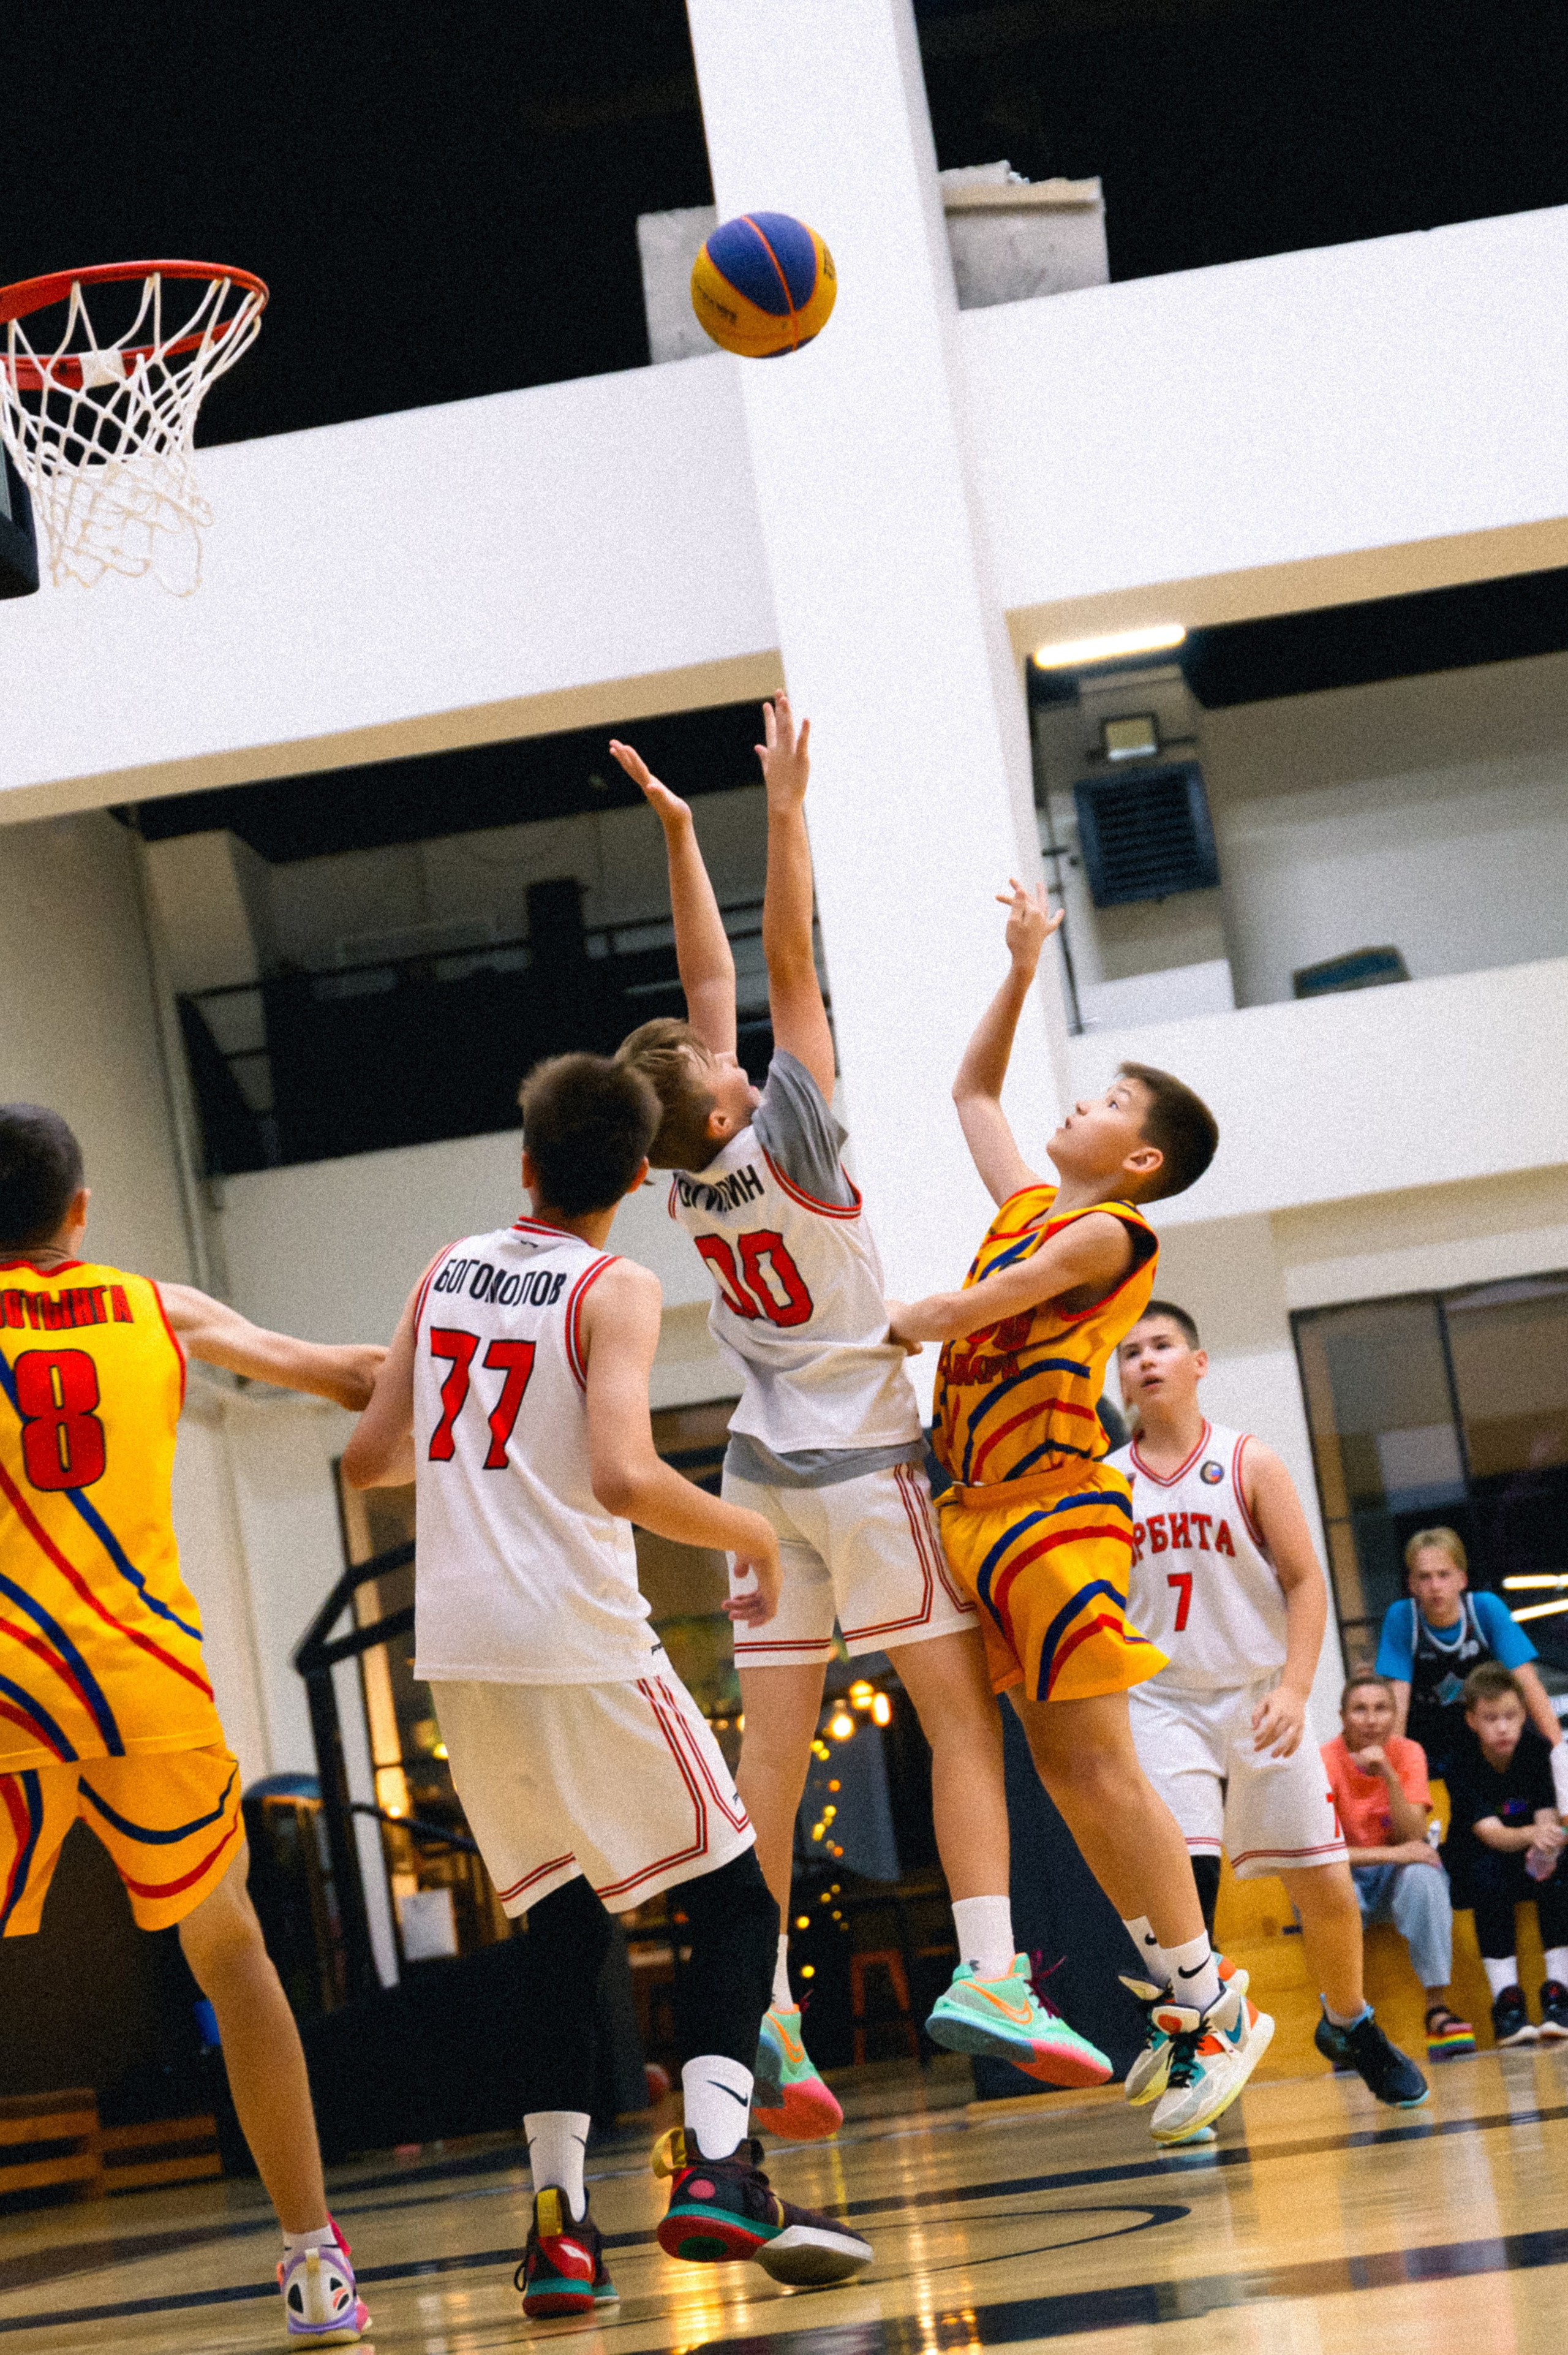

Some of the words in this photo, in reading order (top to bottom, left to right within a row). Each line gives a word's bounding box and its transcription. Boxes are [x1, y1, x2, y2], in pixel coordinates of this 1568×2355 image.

[13, 1348, 107, 1492] 8
[428, 1326, 537, 1469] 77
[1131, 1511, 1236, 1568] РБИТА
[1167, 1572, 1193, 1631] 7
